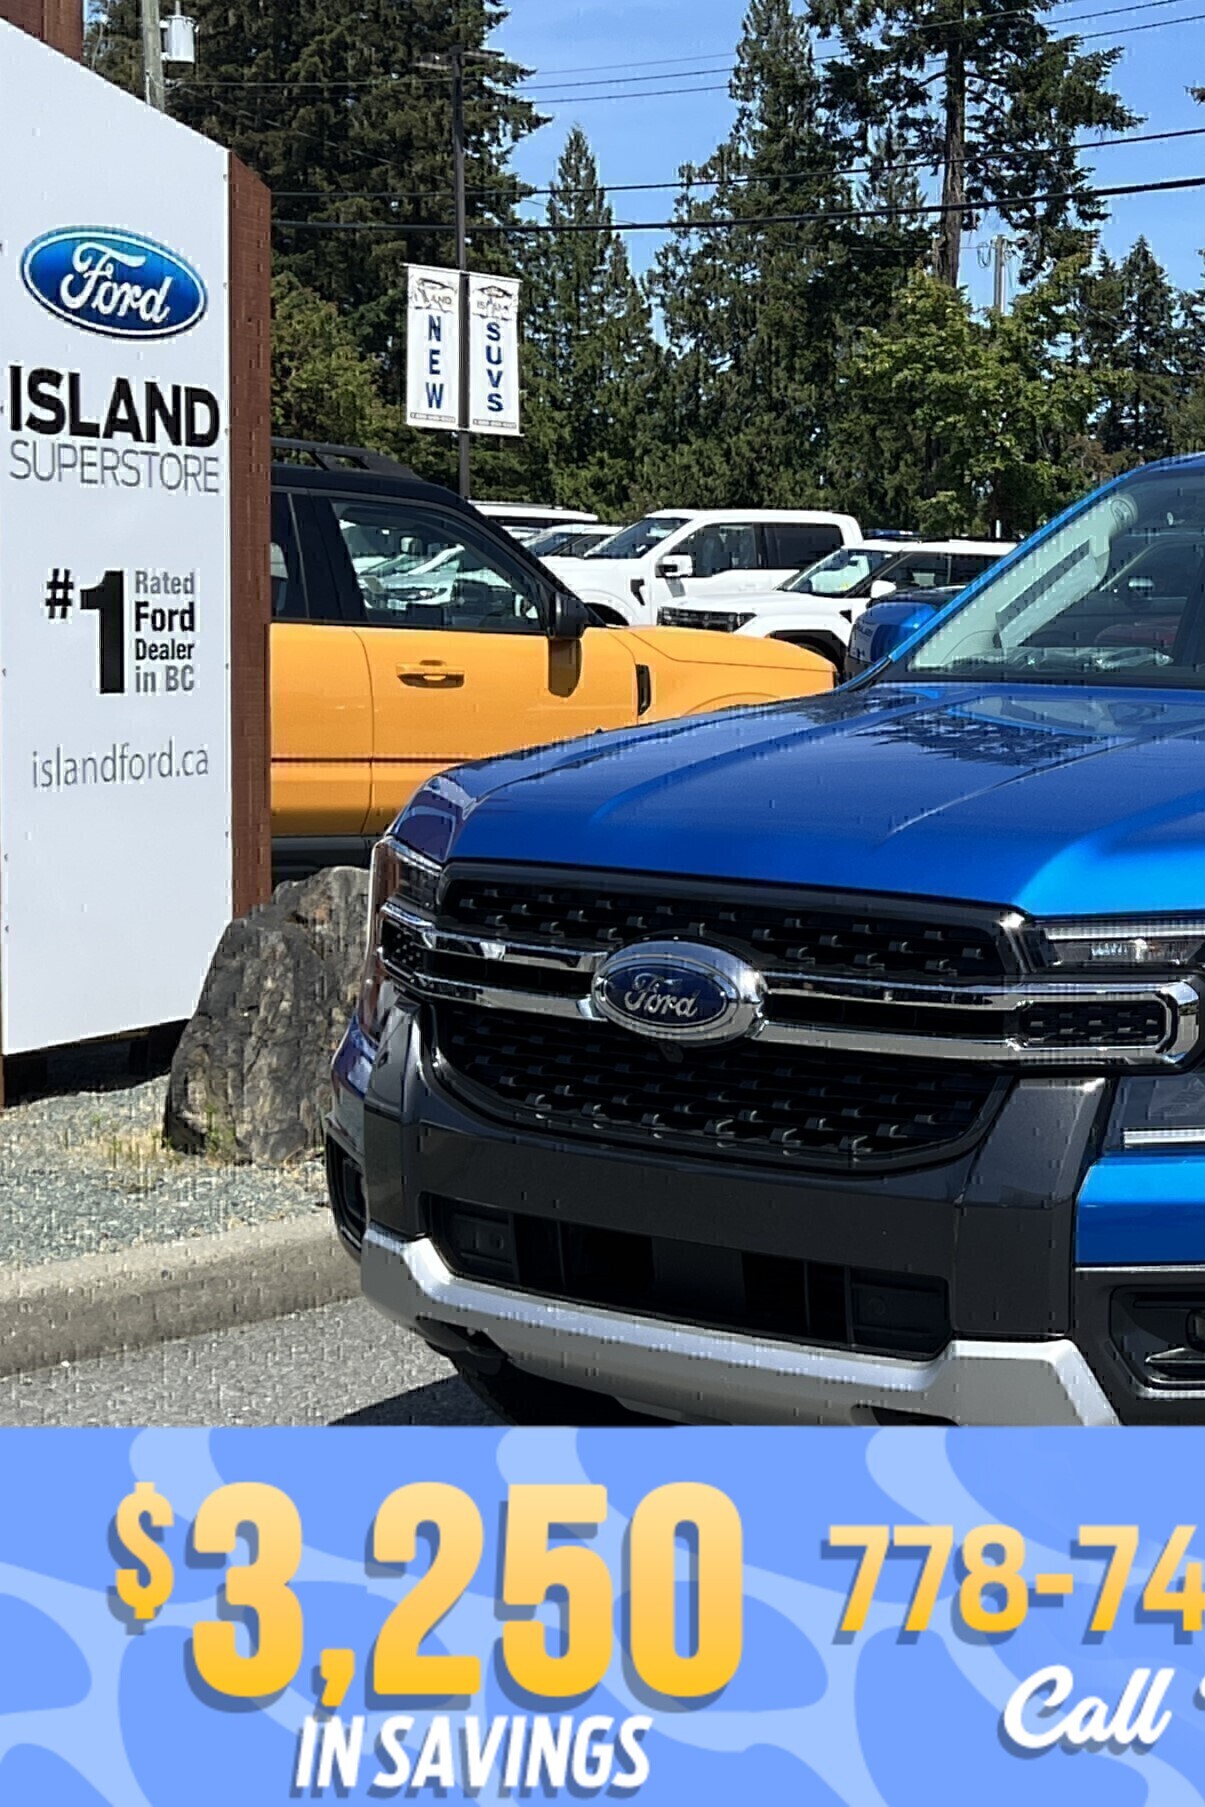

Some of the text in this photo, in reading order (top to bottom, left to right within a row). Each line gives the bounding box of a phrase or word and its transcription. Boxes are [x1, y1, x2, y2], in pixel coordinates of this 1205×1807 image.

[60, 241, 173, 323] Ford
[425, 314, 444, 409] NEW
[485, 321, 504, 412] SUVS
[9, 365, 220, 447] ISLAND
[9, 439, 219, 493] SUPERSTORE
[134, 570, 194, 594] Rated
[45, 568, 125, 694] #1
[134, 601, 195, 632] Ford
[135, 638, 195, 660] Dealer
[135, 665, 195, 692] in BC
[32, 739, 209, 788] islandford.ca
[624, 973, 700, 1018] Ford
